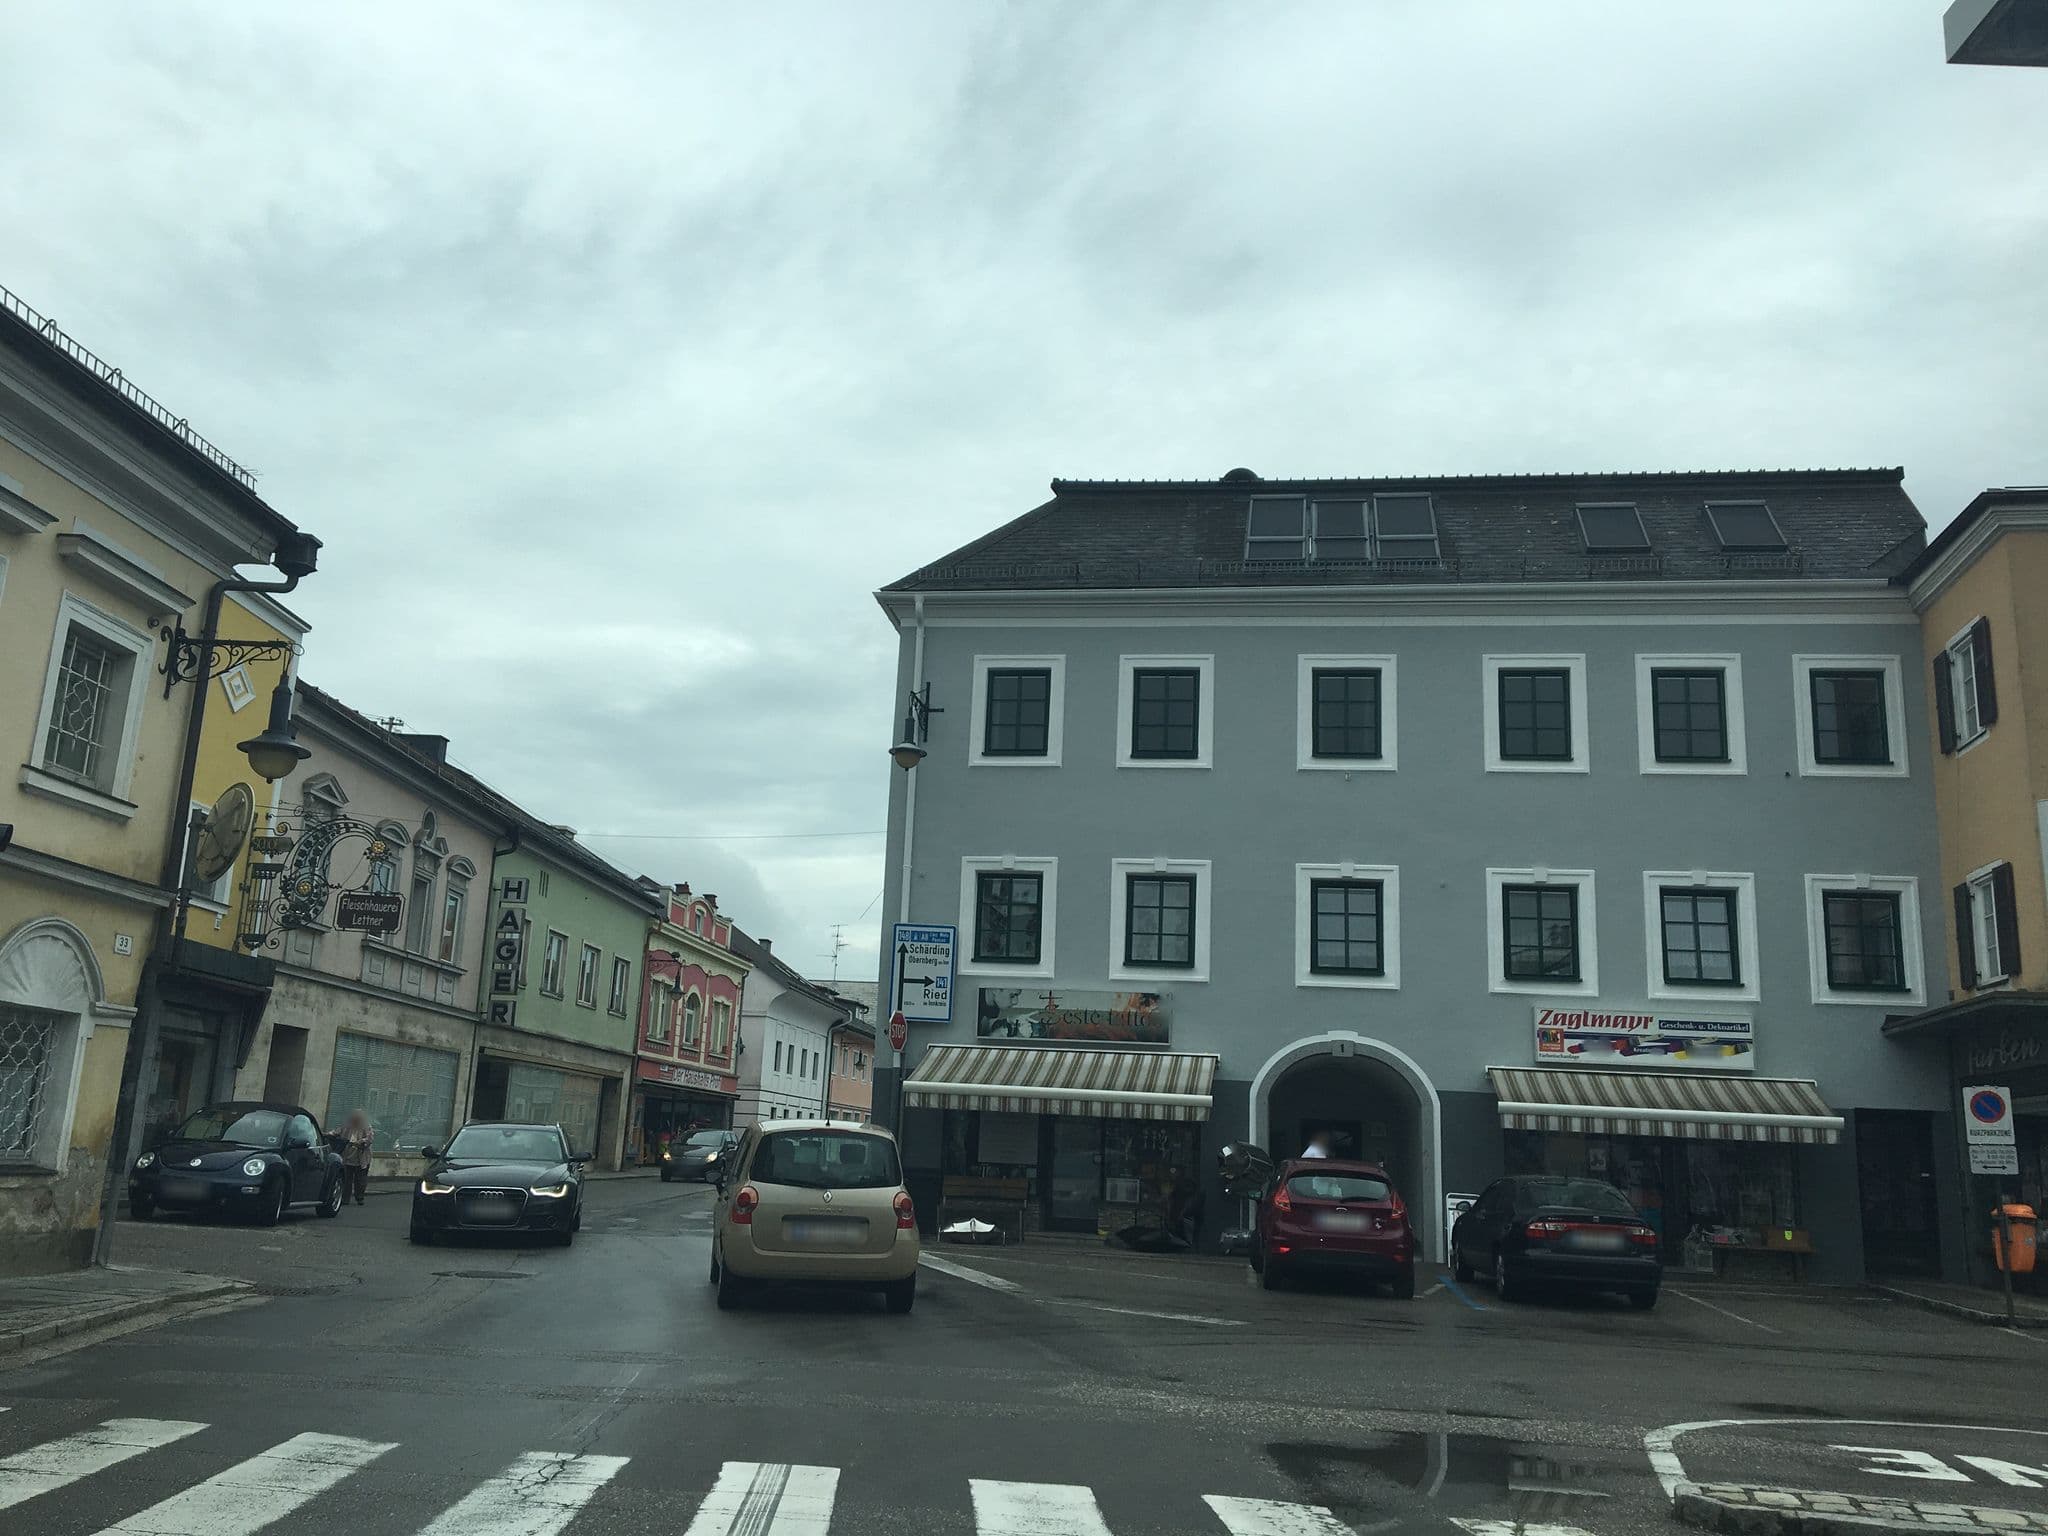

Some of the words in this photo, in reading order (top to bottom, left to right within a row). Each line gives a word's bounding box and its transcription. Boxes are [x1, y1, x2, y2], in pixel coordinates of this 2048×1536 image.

[341, 897, 400, 913] Fleischhauerei
[351, 913, 384, 926] Lettner
[119, 937, 129, 948] 33
[491, 880, 522, 1024] HAGER
[909, 943, 951, 958] Schärding
[908, 955, 938, 966] Obernberg
[936, 977, 947, 988] 141
[923, 988, 948, 1000] Ried
[1537, 1009, 1654, 1032] Zaglmayr
[1659, 1020, 1697, 1030] Geschenk-
[1707, 1022, 1749, 1032] Dekoartikel
[890, 1023, 905, 1039] STOP
[1969, 1129, 2012, 1137] KURZPARKZONE
